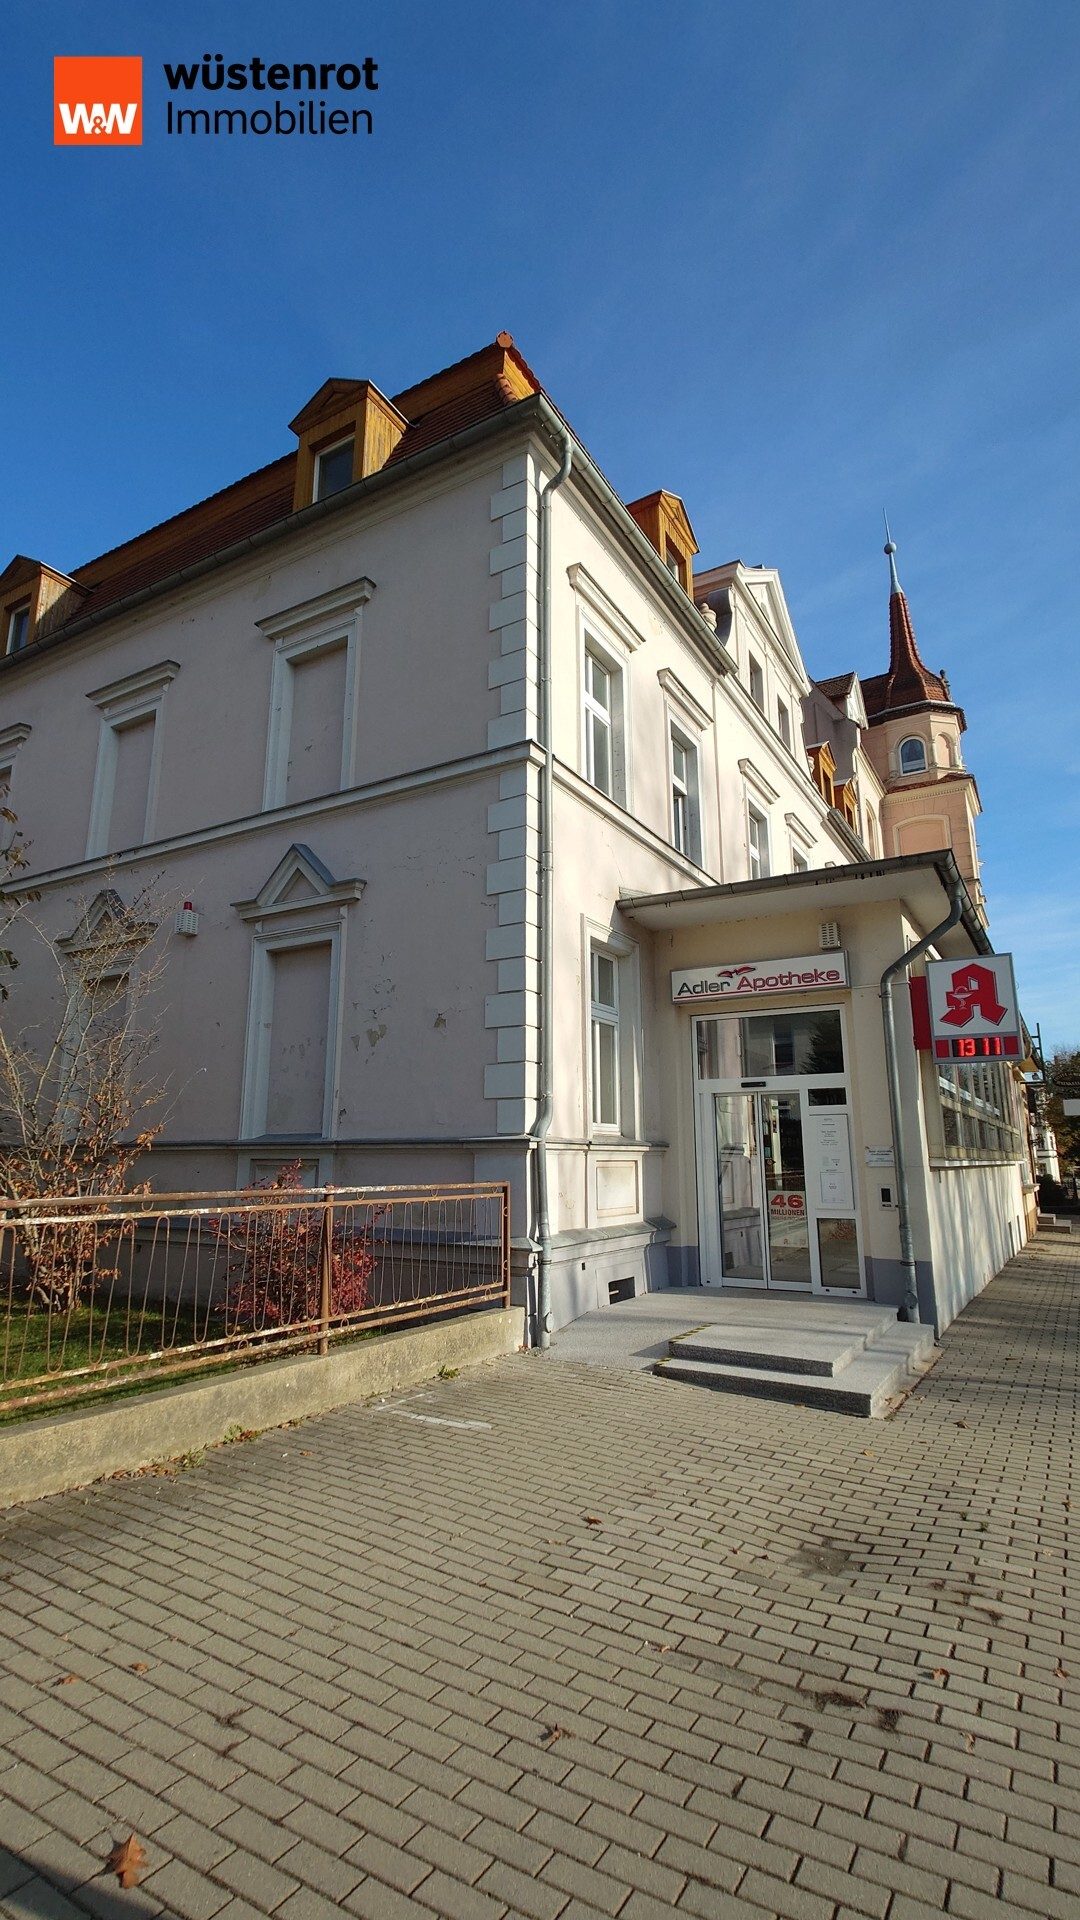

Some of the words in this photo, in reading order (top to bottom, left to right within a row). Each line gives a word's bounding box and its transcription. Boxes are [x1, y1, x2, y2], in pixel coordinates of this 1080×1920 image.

[677, 980, 731, 996] Adler
[736, 968, 840, 992] Apotheke
[770, 1194, 804, 1209] 46
